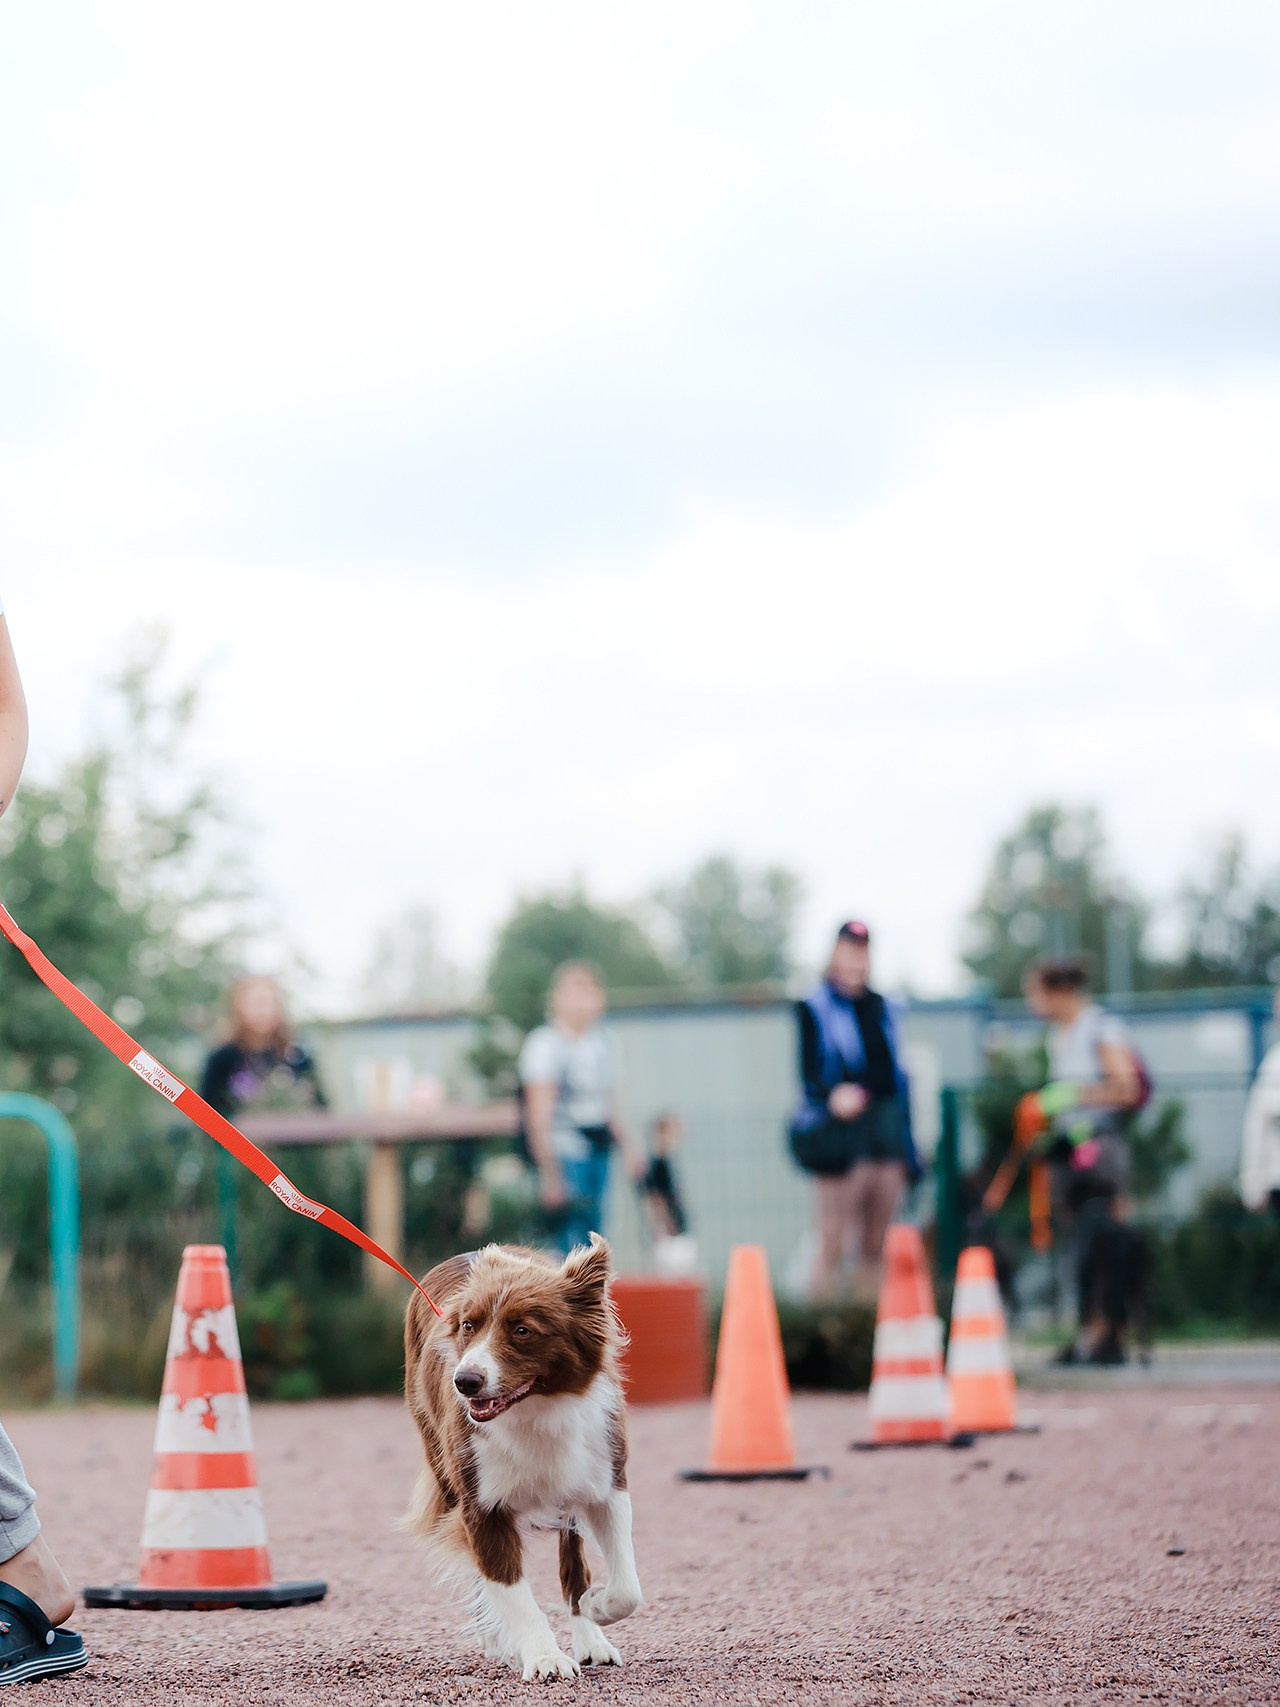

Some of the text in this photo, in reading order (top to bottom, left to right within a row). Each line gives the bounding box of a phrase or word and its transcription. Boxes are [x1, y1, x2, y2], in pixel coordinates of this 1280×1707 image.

[130, 1059, 177, 1099] ROYAL CANIN
[270, 1181, 318, 1218] ROYAL CANIN
